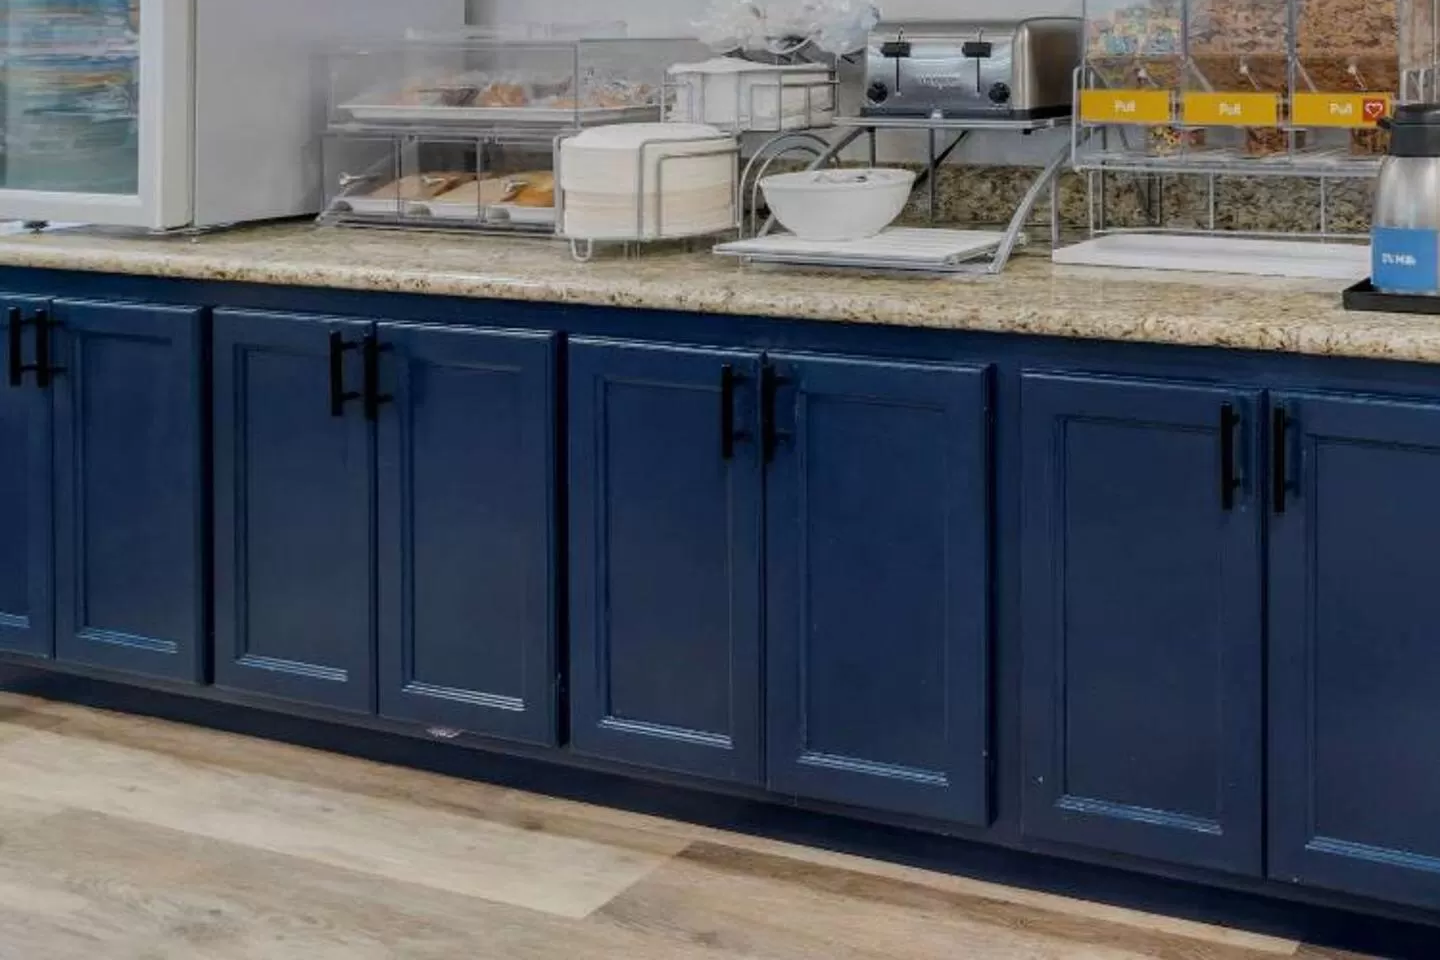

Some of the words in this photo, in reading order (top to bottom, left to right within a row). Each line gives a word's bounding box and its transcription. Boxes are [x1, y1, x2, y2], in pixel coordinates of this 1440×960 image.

[1114, 99, 1136, 114] Pull
[1218, 102, 1241, 117] Pull
[1329, 98, 1353, 115] Pull
